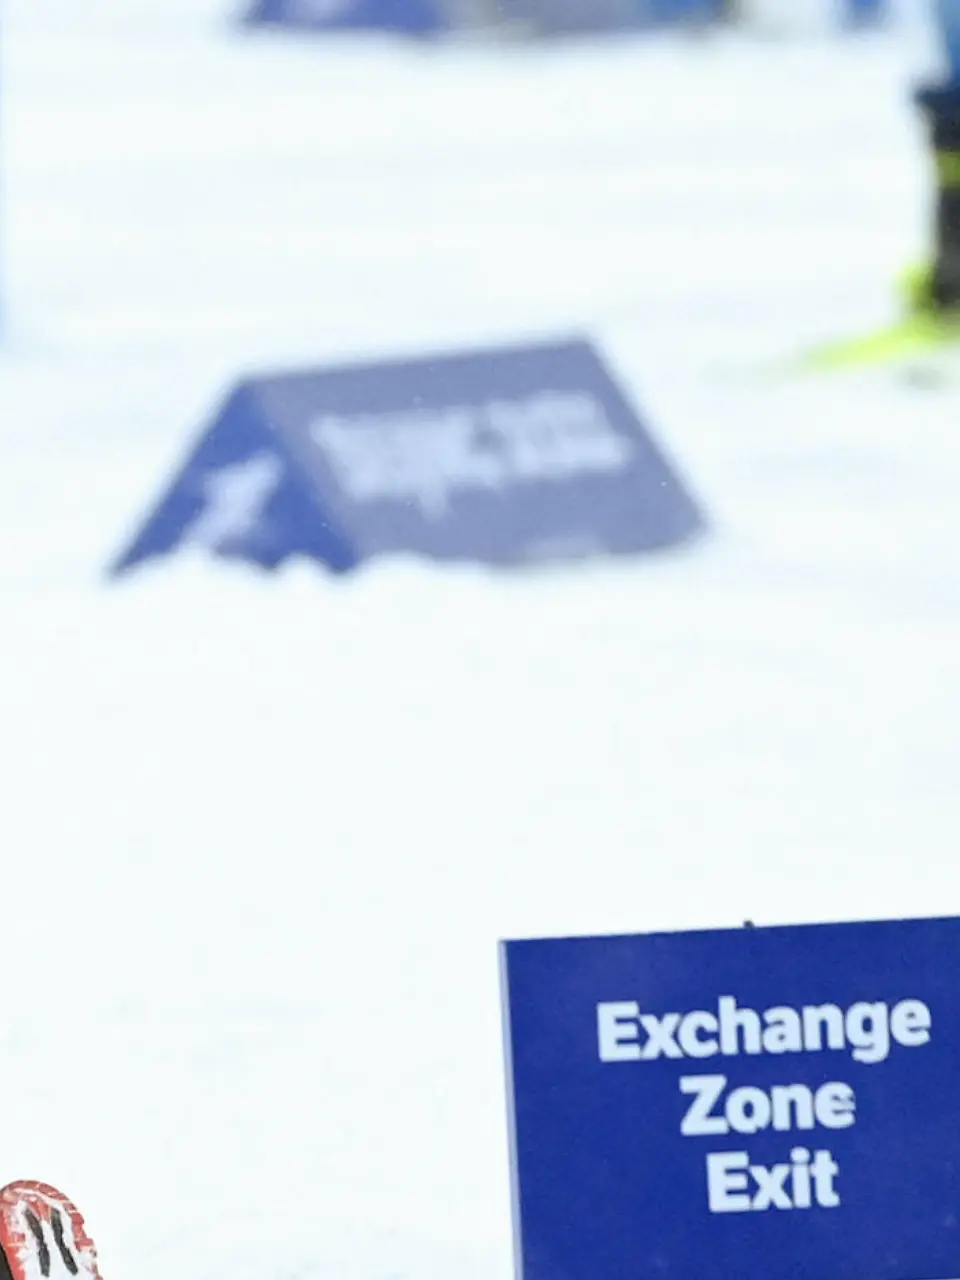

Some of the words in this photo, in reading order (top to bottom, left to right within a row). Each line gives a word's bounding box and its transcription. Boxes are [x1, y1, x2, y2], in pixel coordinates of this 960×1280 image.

[596, 995, 932, 1064] Exchange
[679, 1074, 857, 1136] Zone
[706, 1147, 841, 1213] Exit
